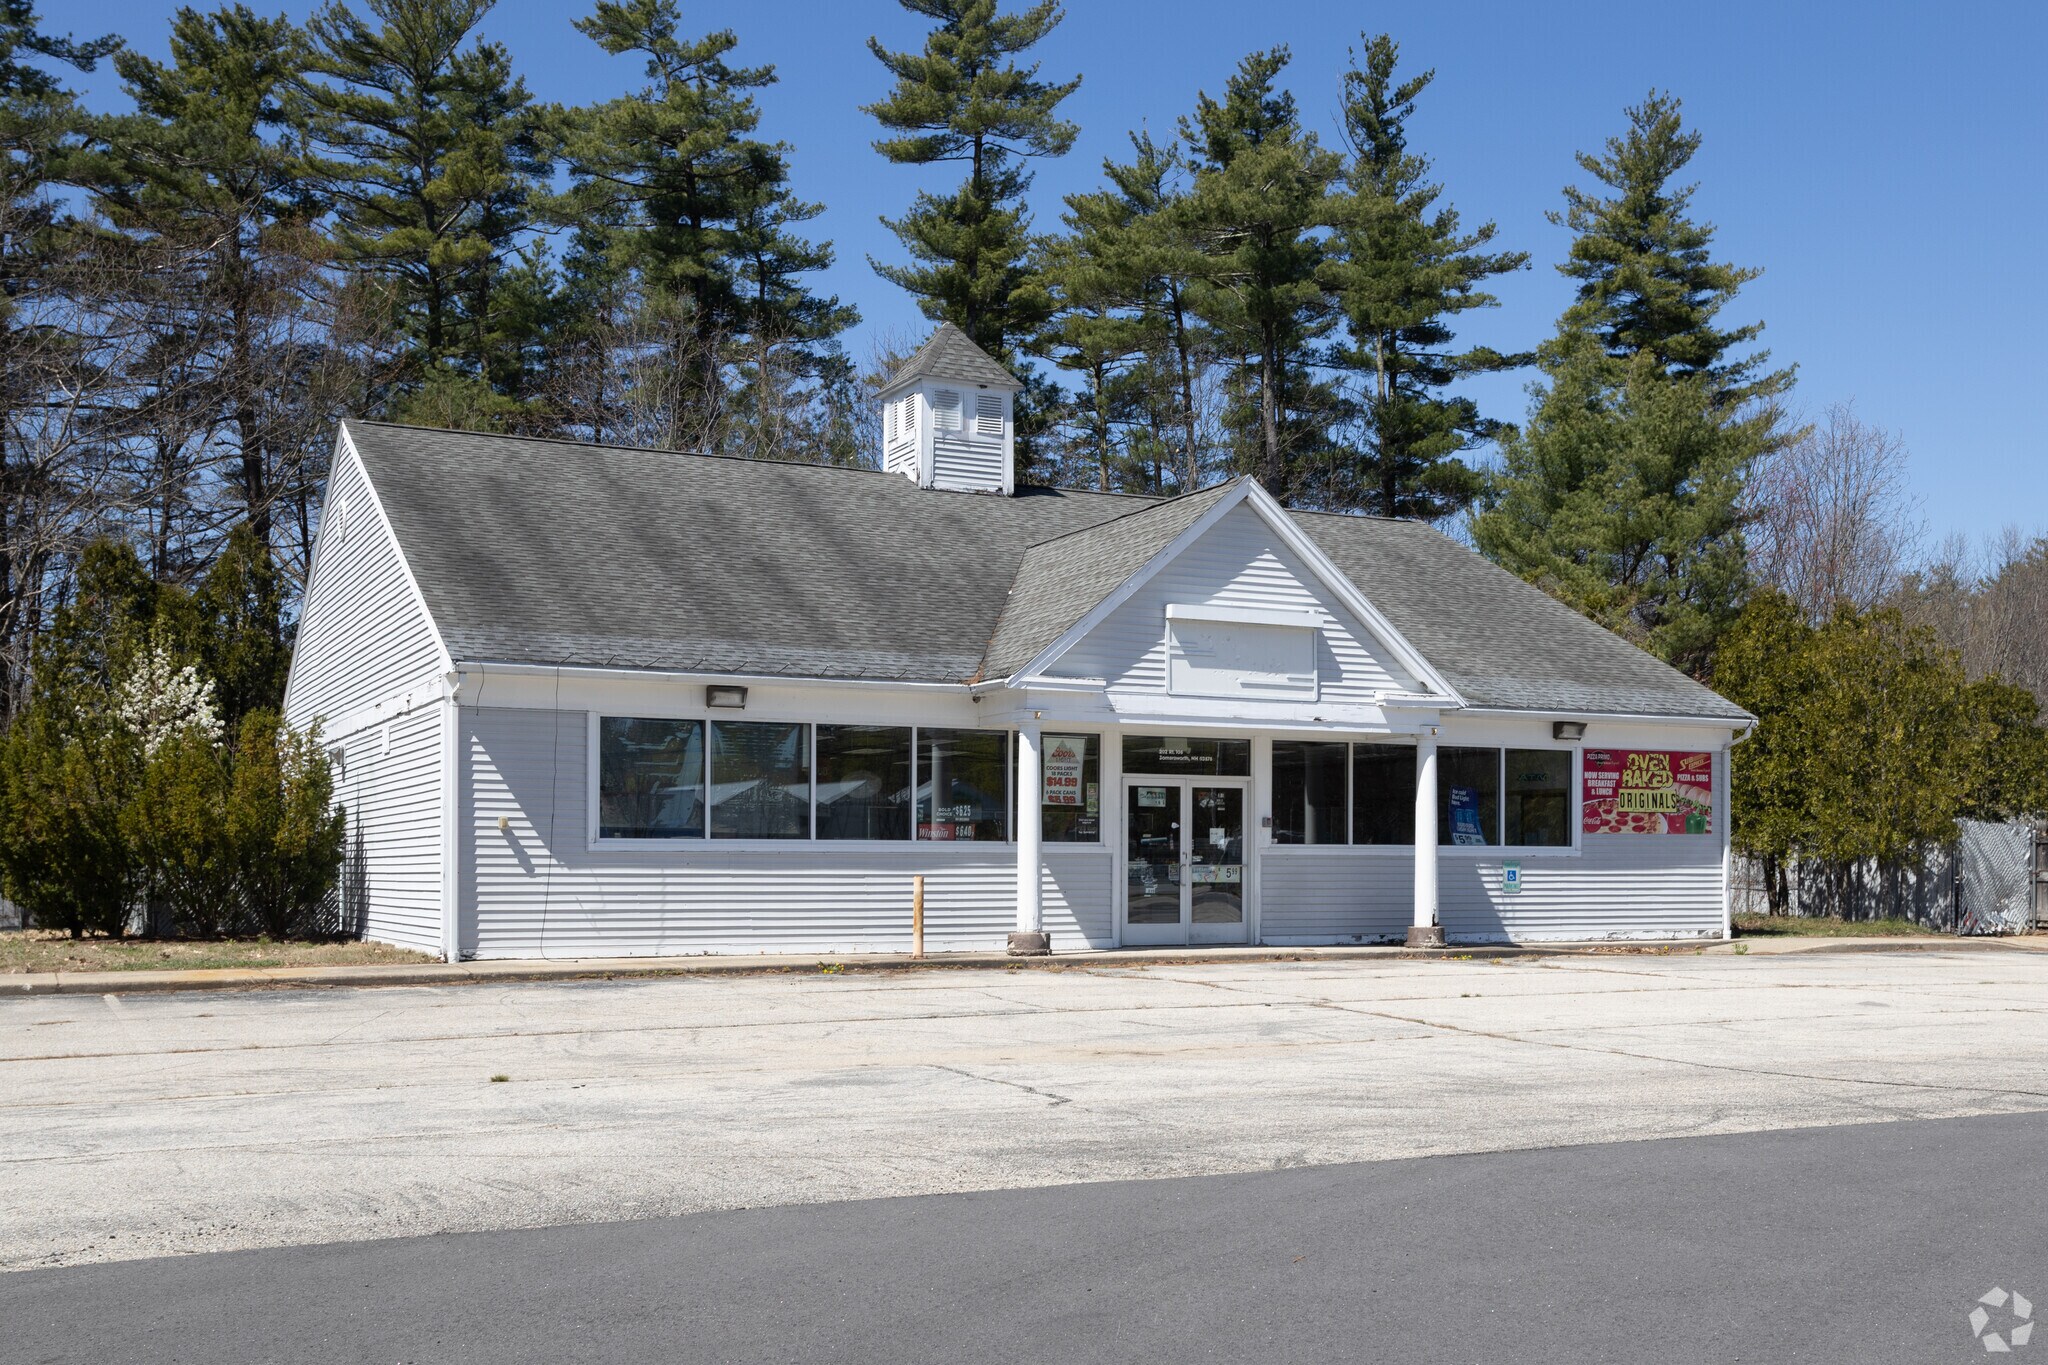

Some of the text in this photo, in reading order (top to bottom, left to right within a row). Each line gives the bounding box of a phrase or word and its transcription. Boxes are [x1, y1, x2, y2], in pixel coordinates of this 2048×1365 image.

[1627, 753, 1670, 771] OVEN
[1584, 771, 1620, 780] NOW SERVING
[1622, 769, 1674, 788] BAKED
[1677, 773, 1691, 782] PIZZA
[1695, 774, 1709, 782] SUBS
[1046, 776, 1078, 787] $14.99
[1587, 779, 1617, 788] BREAKFAST
[1591, 787, 1613, 796] & LUNCH
[1619, 791, 1677, 809] ORIGINALS
[918, 828, 949, 838] Winston
